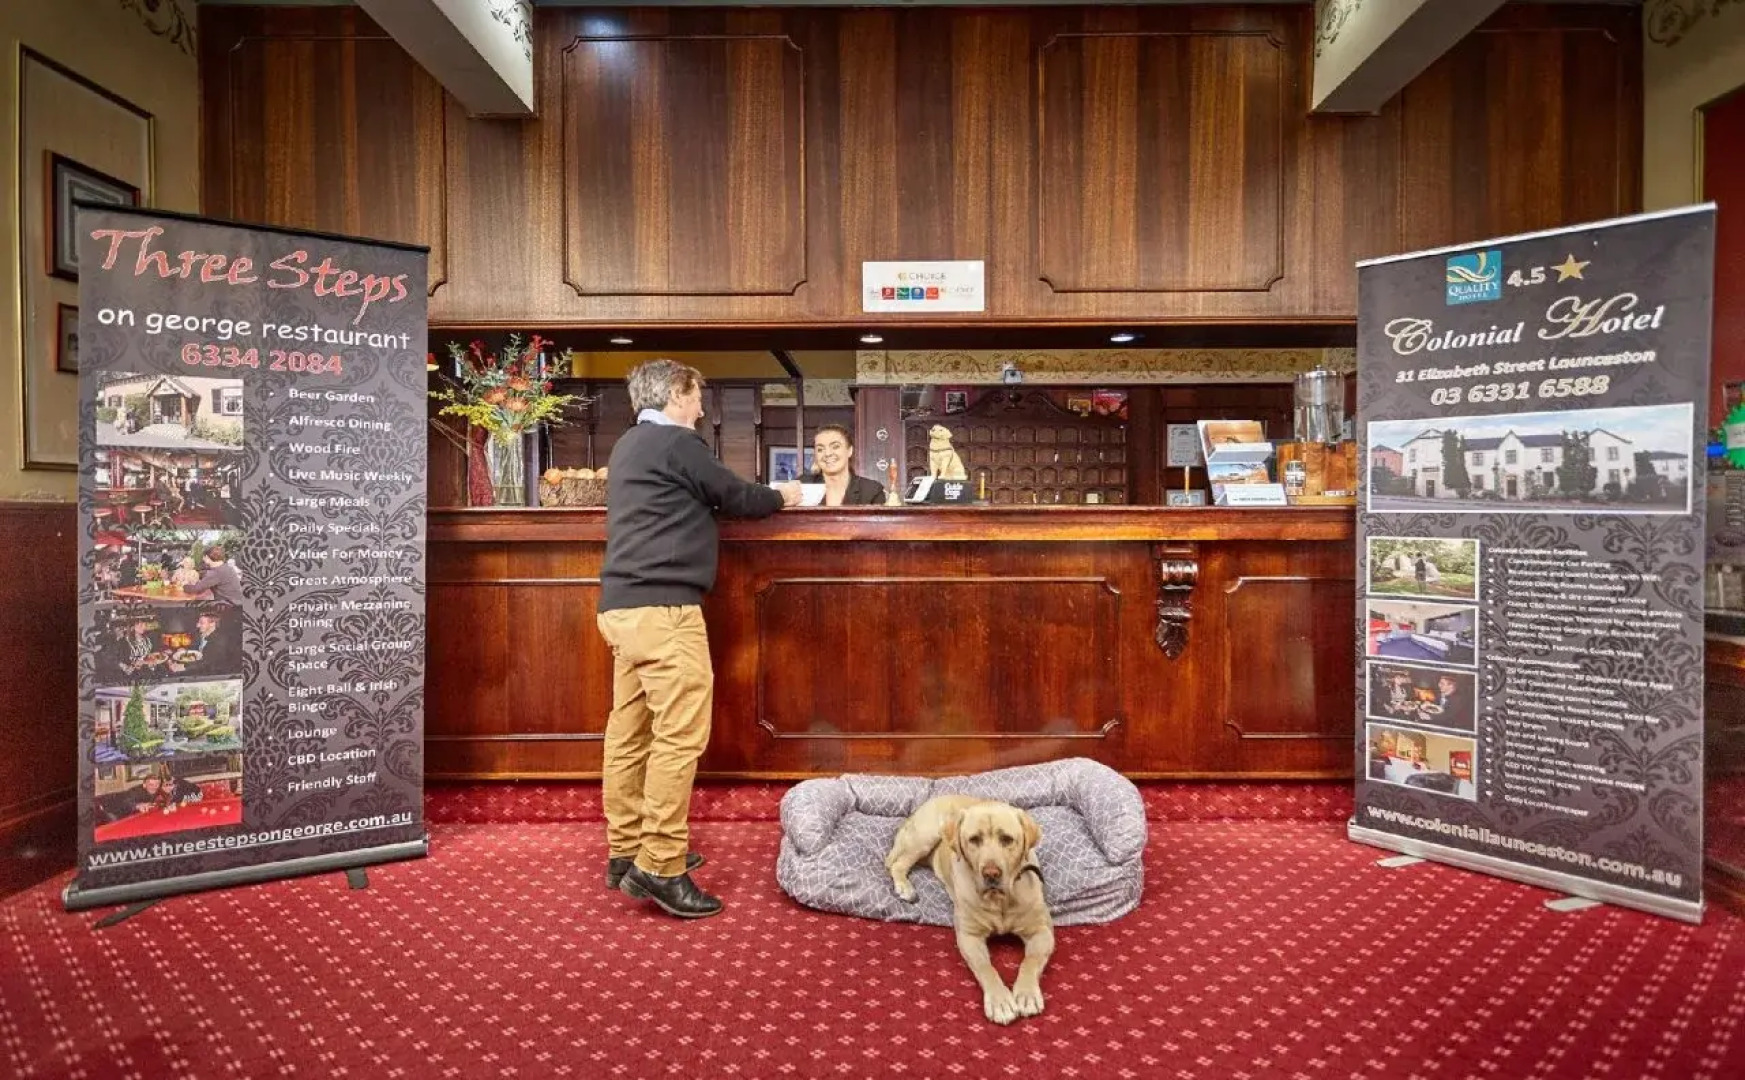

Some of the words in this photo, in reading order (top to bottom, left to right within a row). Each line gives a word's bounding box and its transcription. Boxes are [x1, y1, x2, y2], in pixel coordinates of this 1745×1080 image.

[91, 226, 257, 285] Three
[267, 251, 408, 325] Steps
[1448, 281, 1499, 297] QUALITY
[1507, 266, 1547, 287] 4.5
[97, 308, 135, 327] on
[145, 309, 252, 339] george
[262, 323, 410, 350] restaurant
[1384, 317, 1525, 355] Colonial
[1537, 292, 1666, 340] Hotel
[181, 343, 260, 369] 6334
[269, 350, 344, 376] 2084
[1395, 369, 1415, 384] 31
[1417, 362, 1491, 382] Elizabeth
[1493, 358, 1546, 376] Street
[1548, 348, 1657, 370] Launceston
[288, 388, 320, 400] Beer
[325, 390, 375, 403] Garden
[1430, 386, 1462, 406] 03
[1467, 380, 1531, 404] 6331
[1538, 375, 1611, 398] 6588
[288, 415, 345, 428] Alfresco
[348, 418, 392, 432] Dining
[288, 442, 331, 453] Wood
[334, 444, 361, 455] Fire
[288, 469, 316, 480] Live
[320, 470, 361, 481] Music
[363, 471, 413, 484] Weekly
[288, 496, 327, 509] Large
[330, 497, 370, 508] Meals
[288, 523, 323, 535] Daily
[328, 523, 381, 535] Specials
[288, 549, 328, 560] Value
[332, 549, 353, 560] For
[358, 548, 403, 560] Money
[288, 576, 328, 587] Great
[330, 574, 413, 587] Atmosphere
[288, 602, 337, 613] Private
[341, 600, 412, 611] Mezzanine
[288, 617, 334, 629] Dining
[288, 645, 325, 656] Large
[329, 641, 368, 652] Social
[371, 640, 411, 651] Group
[288, 661, 328, 672] Space
[288, 685, 324, 698] Eight
[327, 683, 351, 694] Ball
[355, 682, 366, 692] &
[369, 680, 398, 691] Irish
[288, 701, 327, 713] Bingo
[288, 727, 338, 740] Lounge
[287, 753, 316, 766] CBD
[319, 748, 377, 762] Location
[288, 776, 343, 792] Friendly
[346, 772, 378, 785] Staff
[88, 810, 414, 867] www.threestepsongeorge.com.au
[1366, 803, 1684, 888] www.coloniallaunceston.com.au
